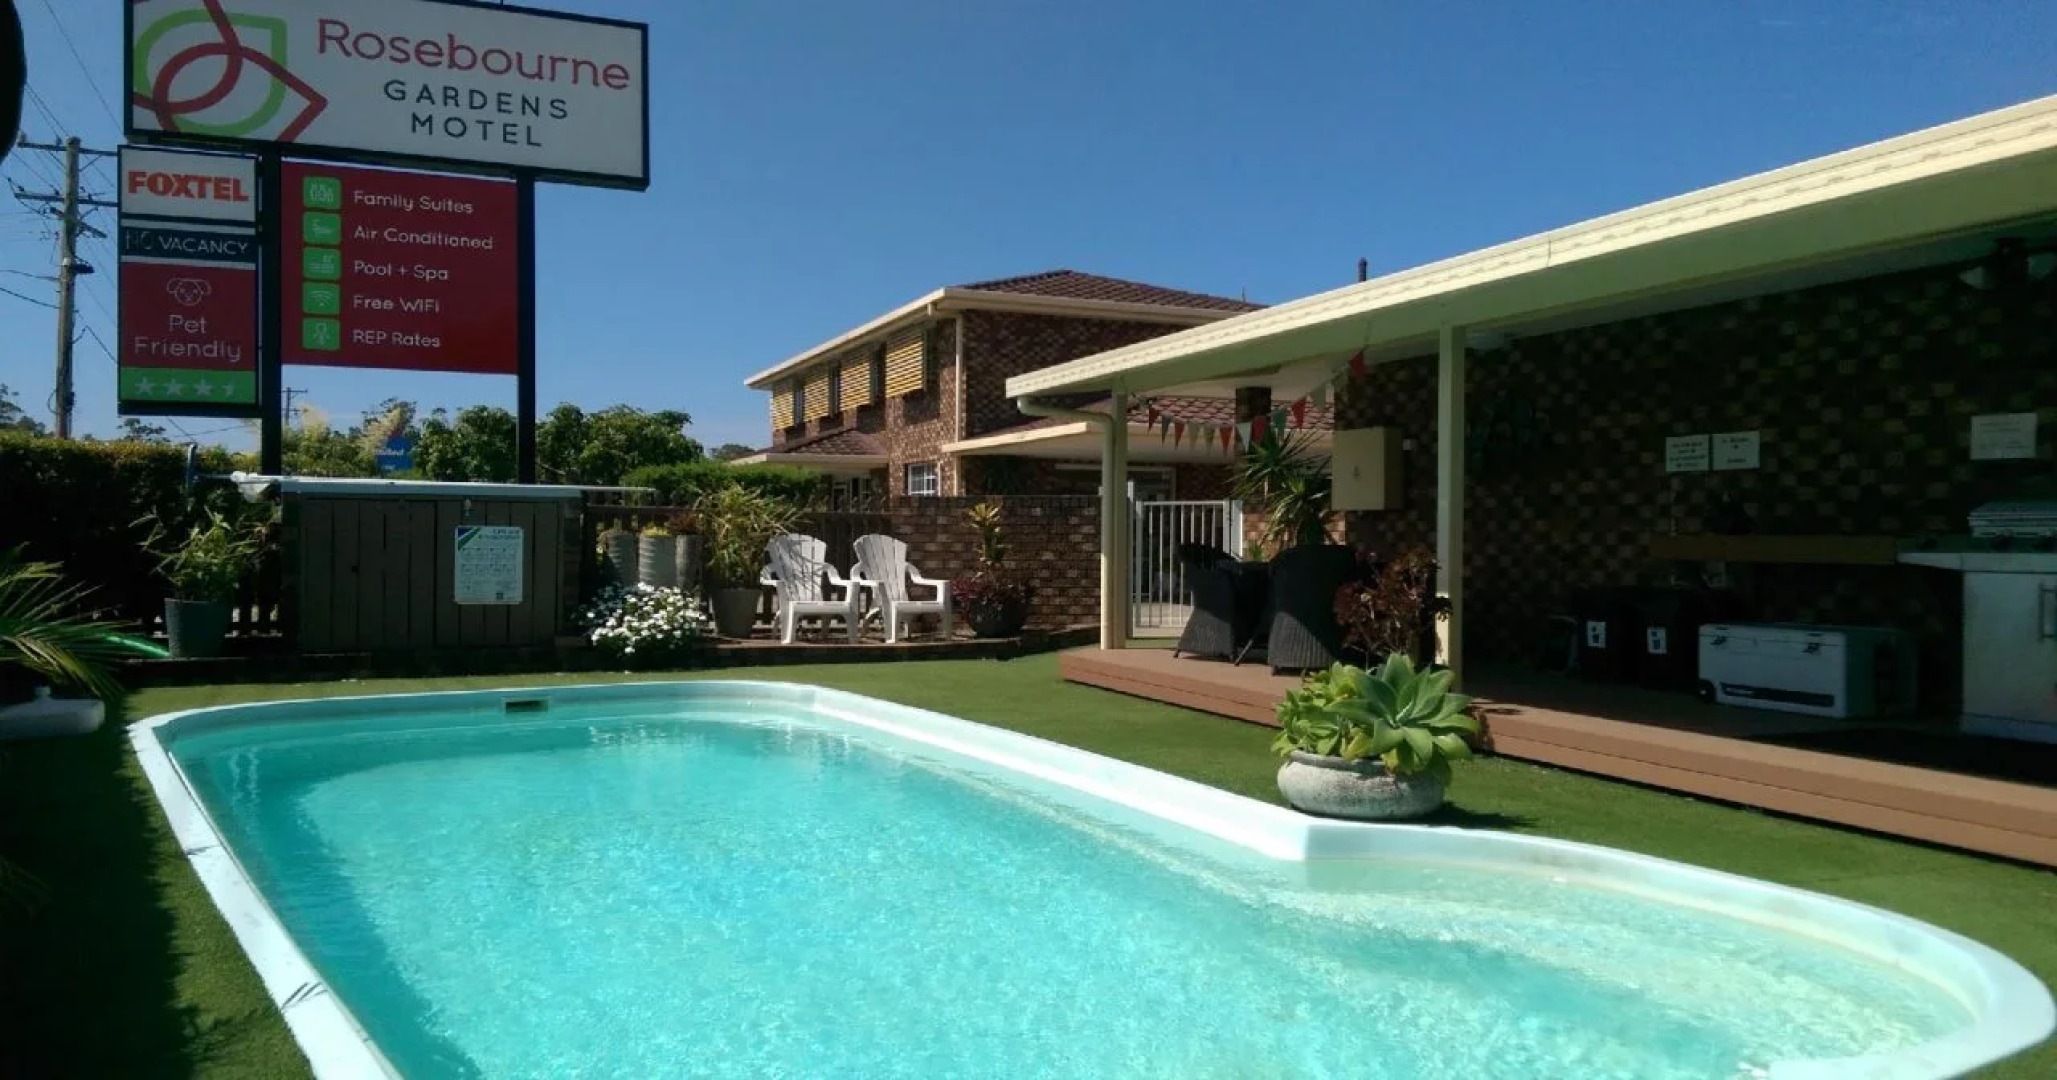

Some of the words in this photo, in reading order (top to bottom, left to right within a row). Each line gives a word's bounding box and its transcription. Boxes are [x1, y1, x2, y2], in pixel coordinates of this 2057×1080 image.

[316, 18, 630, 90] Rosebourne
[384, 79, 569, 120] GARDENS
[411, 112, 542, 147] MOTEL
[127, 170, 250, 203] FOXTEL
[353, 189, 414, 211] Family
[419, 195, 474, 214] Suites
[158, 236, 249, 255] VACANCY
[354, 225, 378, 240] Air
[384, 227, 493, 250] Conditioned
[354, 260, 392, 276] Pool
[413, 264, 449, 282] Spa
[353, 295, 395, 311] Free
[168, 314, 207, 334] Pet
[133, 335, 241, 363] Friendly
[352, 328, 387, 345] REP
[391, 331, 441, 348] Rates
